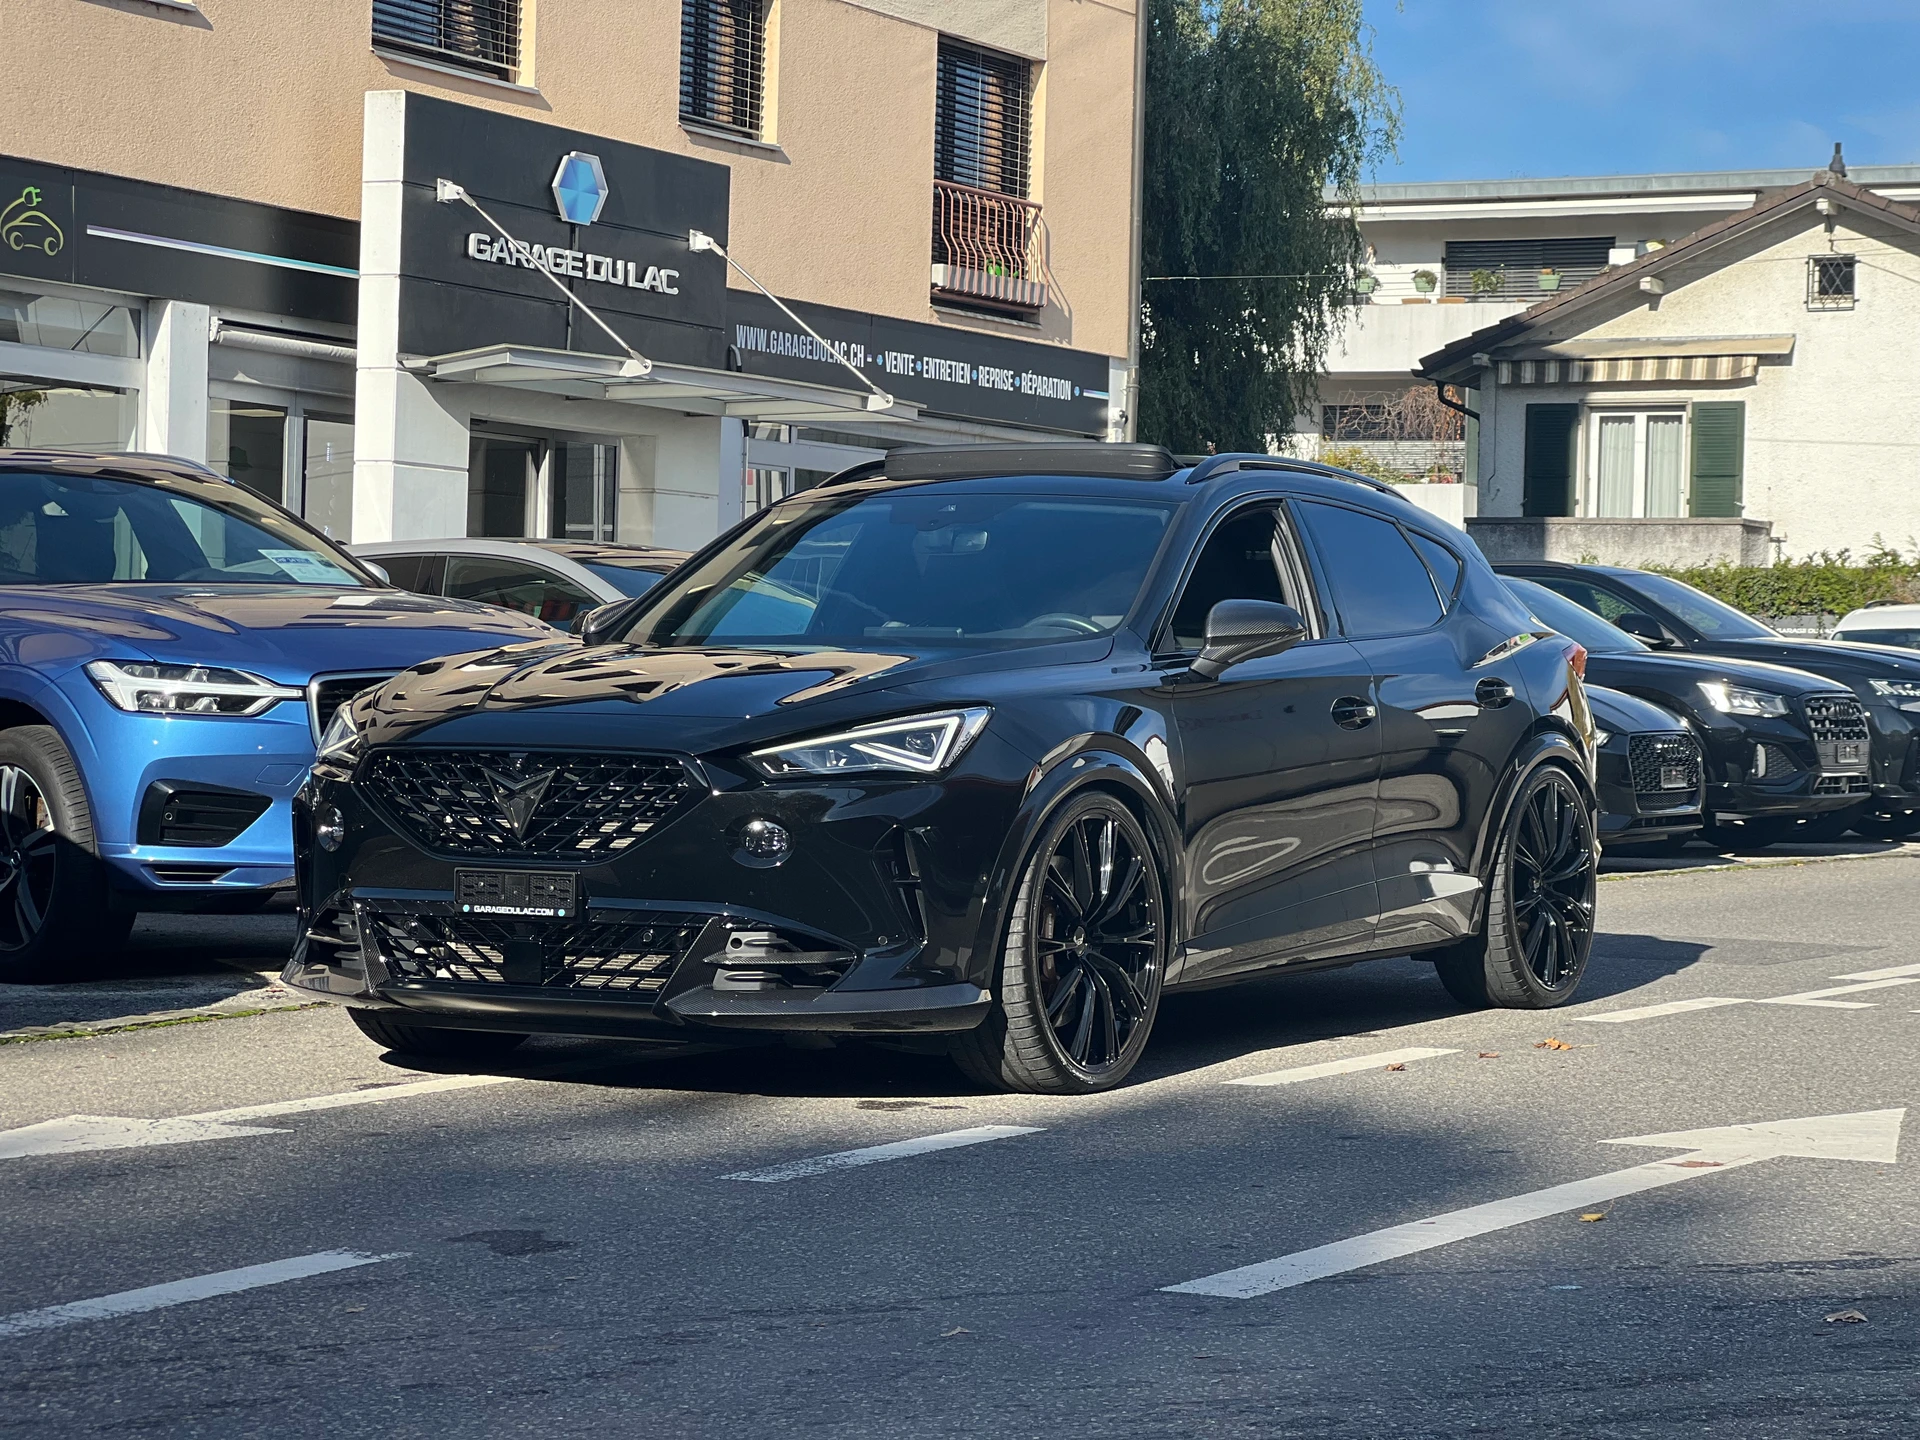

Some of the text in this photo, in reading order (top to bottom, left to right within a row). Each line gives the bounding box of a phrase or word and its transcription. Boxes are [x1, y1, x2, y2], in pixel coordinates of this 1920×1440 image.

[468, 233, 680, 295] GARAGE DU LAC
[885, 350, 1072, 401] VENTE ENTRETIEN REPRISE RÉPARATION
[474, 905, 554, 916] GARAGEDULAC.COM
